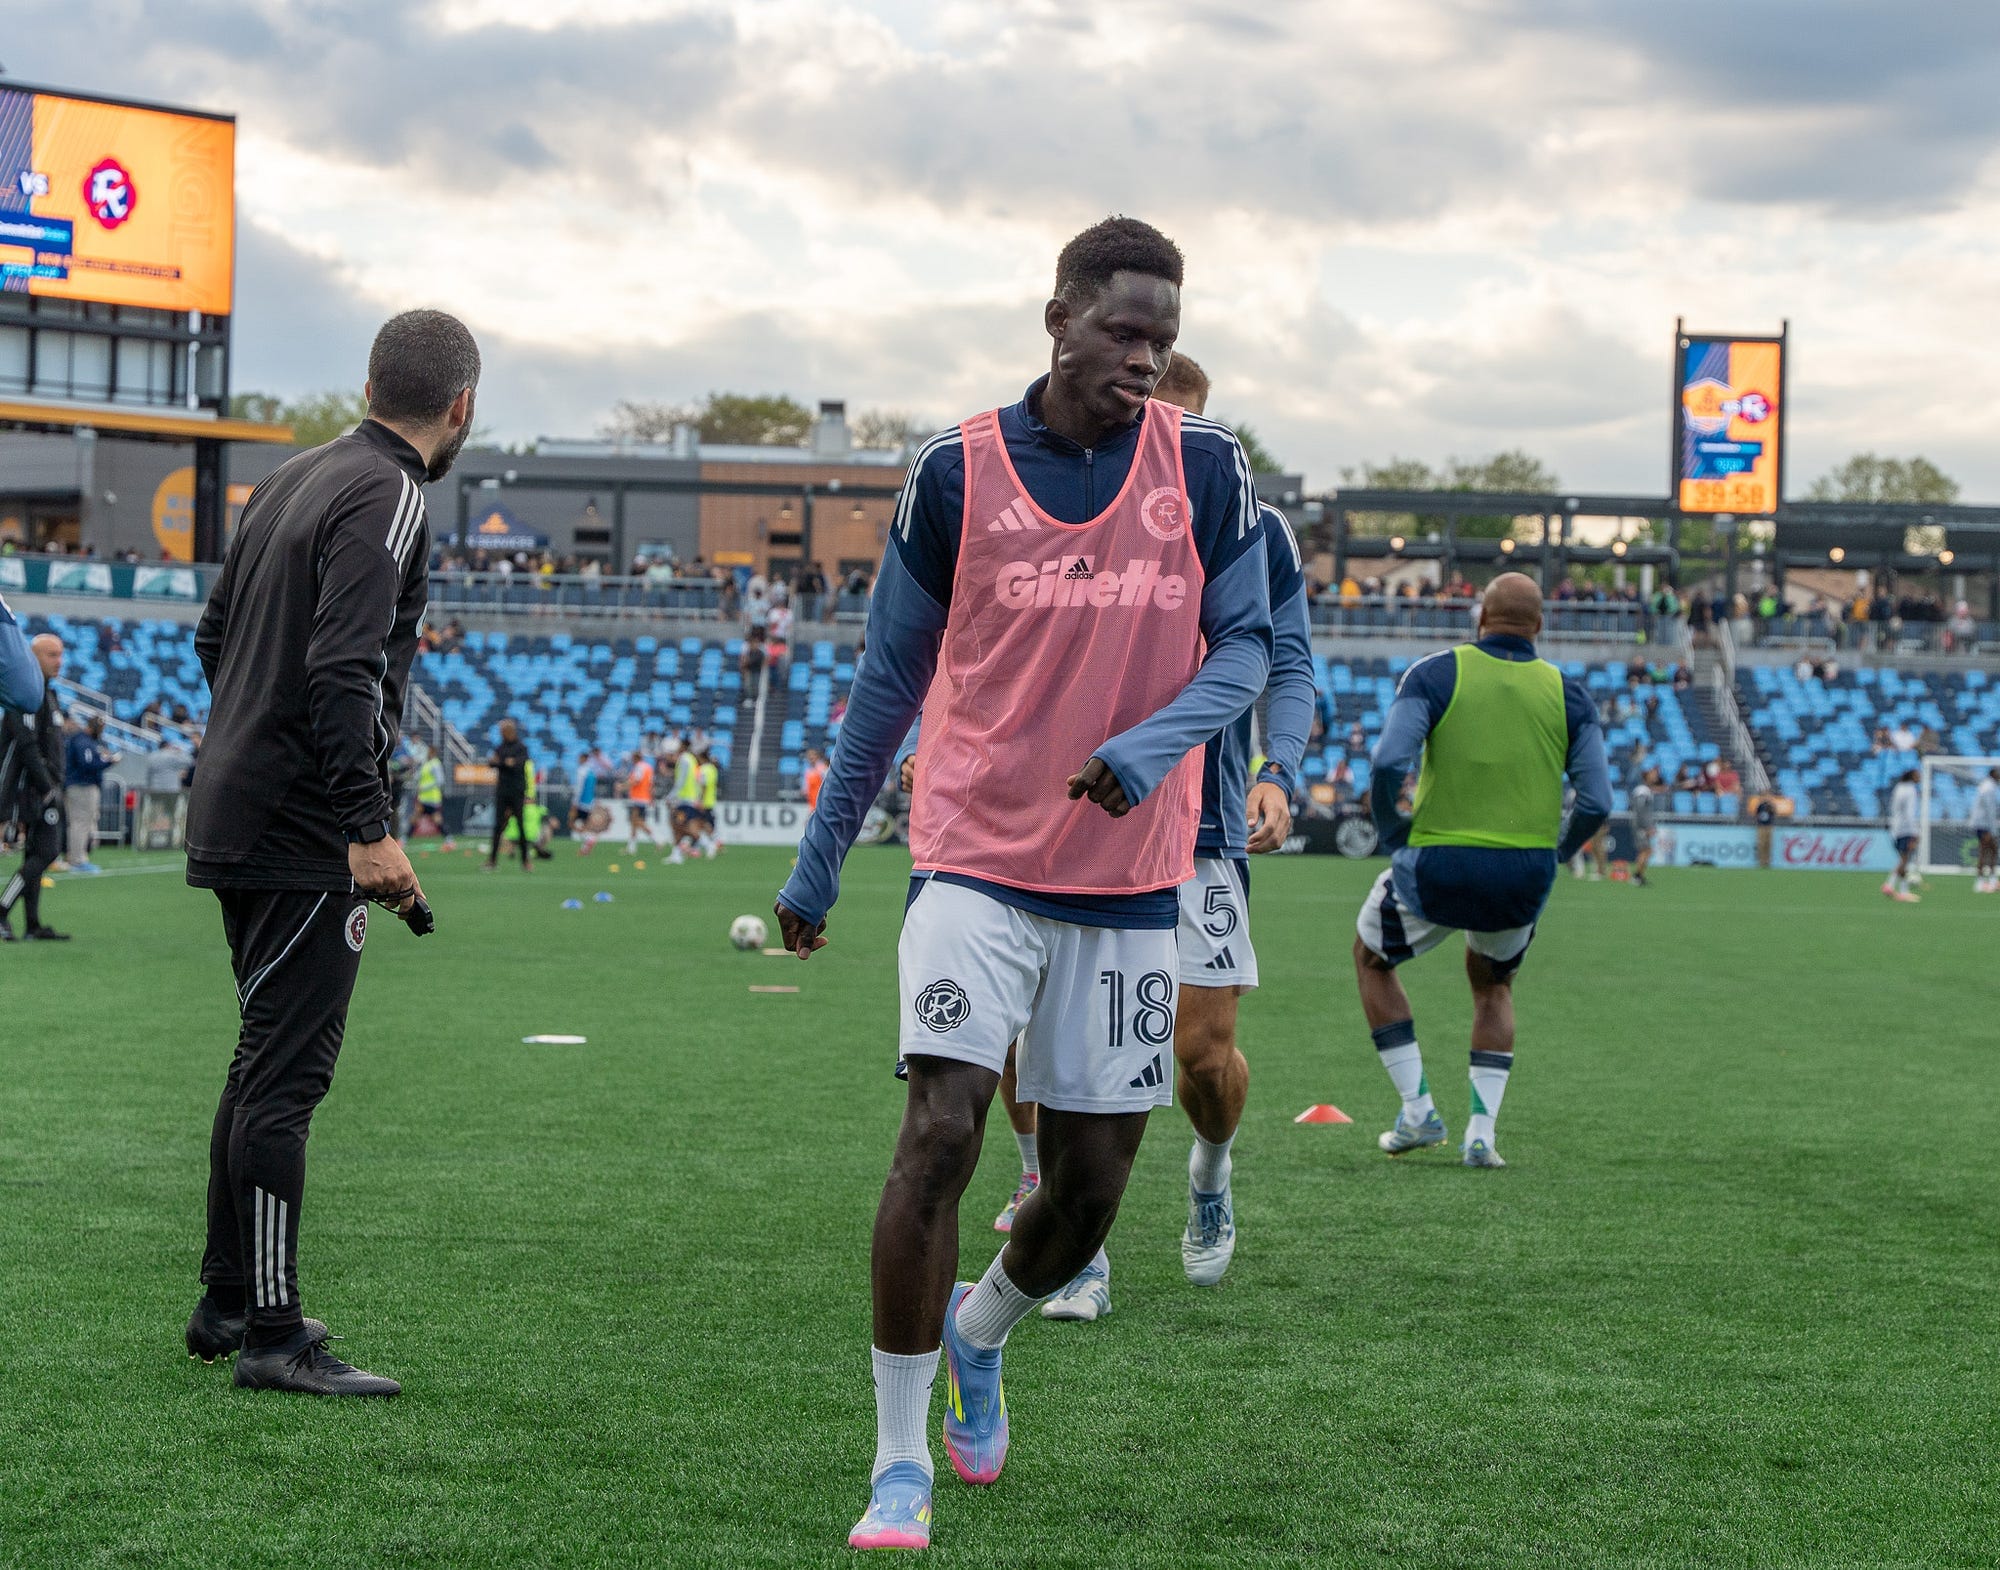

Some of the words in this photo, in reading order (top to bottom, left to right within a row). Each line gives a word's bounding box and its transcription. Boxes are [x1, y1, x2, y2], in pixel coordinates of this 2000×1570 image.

[995, 555, 1187, 611] Gillette
[1064, 570, 1094, 580] adidas
[723, 805, 797, 828] UILD
[1780, 831, 1872, 866] Chill
[1203, 885, 1237, 938] 5
[1100, 968, 1174, 1048] 18
